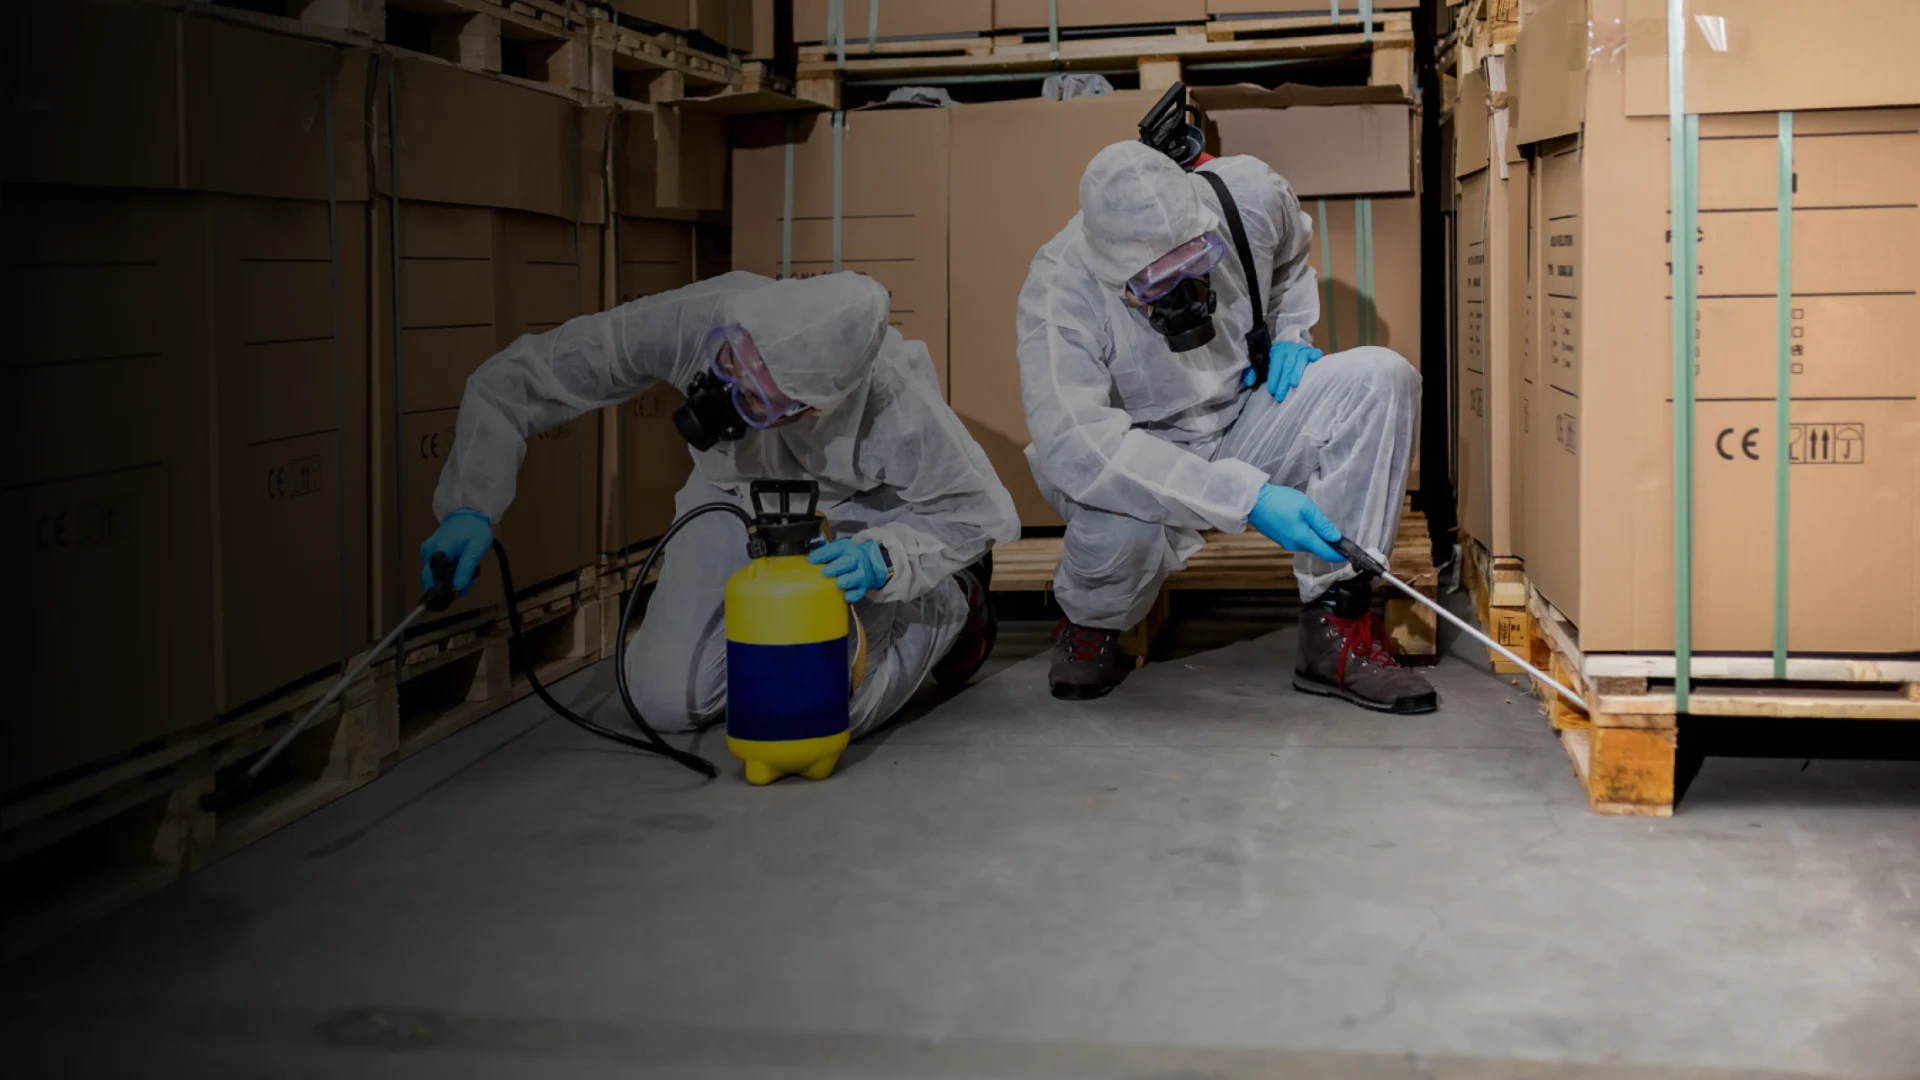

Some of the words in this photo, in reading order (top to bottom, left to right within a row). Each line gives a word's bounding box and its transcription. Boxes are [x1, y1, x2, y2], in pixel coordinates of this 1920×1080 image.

[421, 433, 438, 460] CE
[1716, 427, 1760, 461] CE
[268, 466, 284, 499] CE
